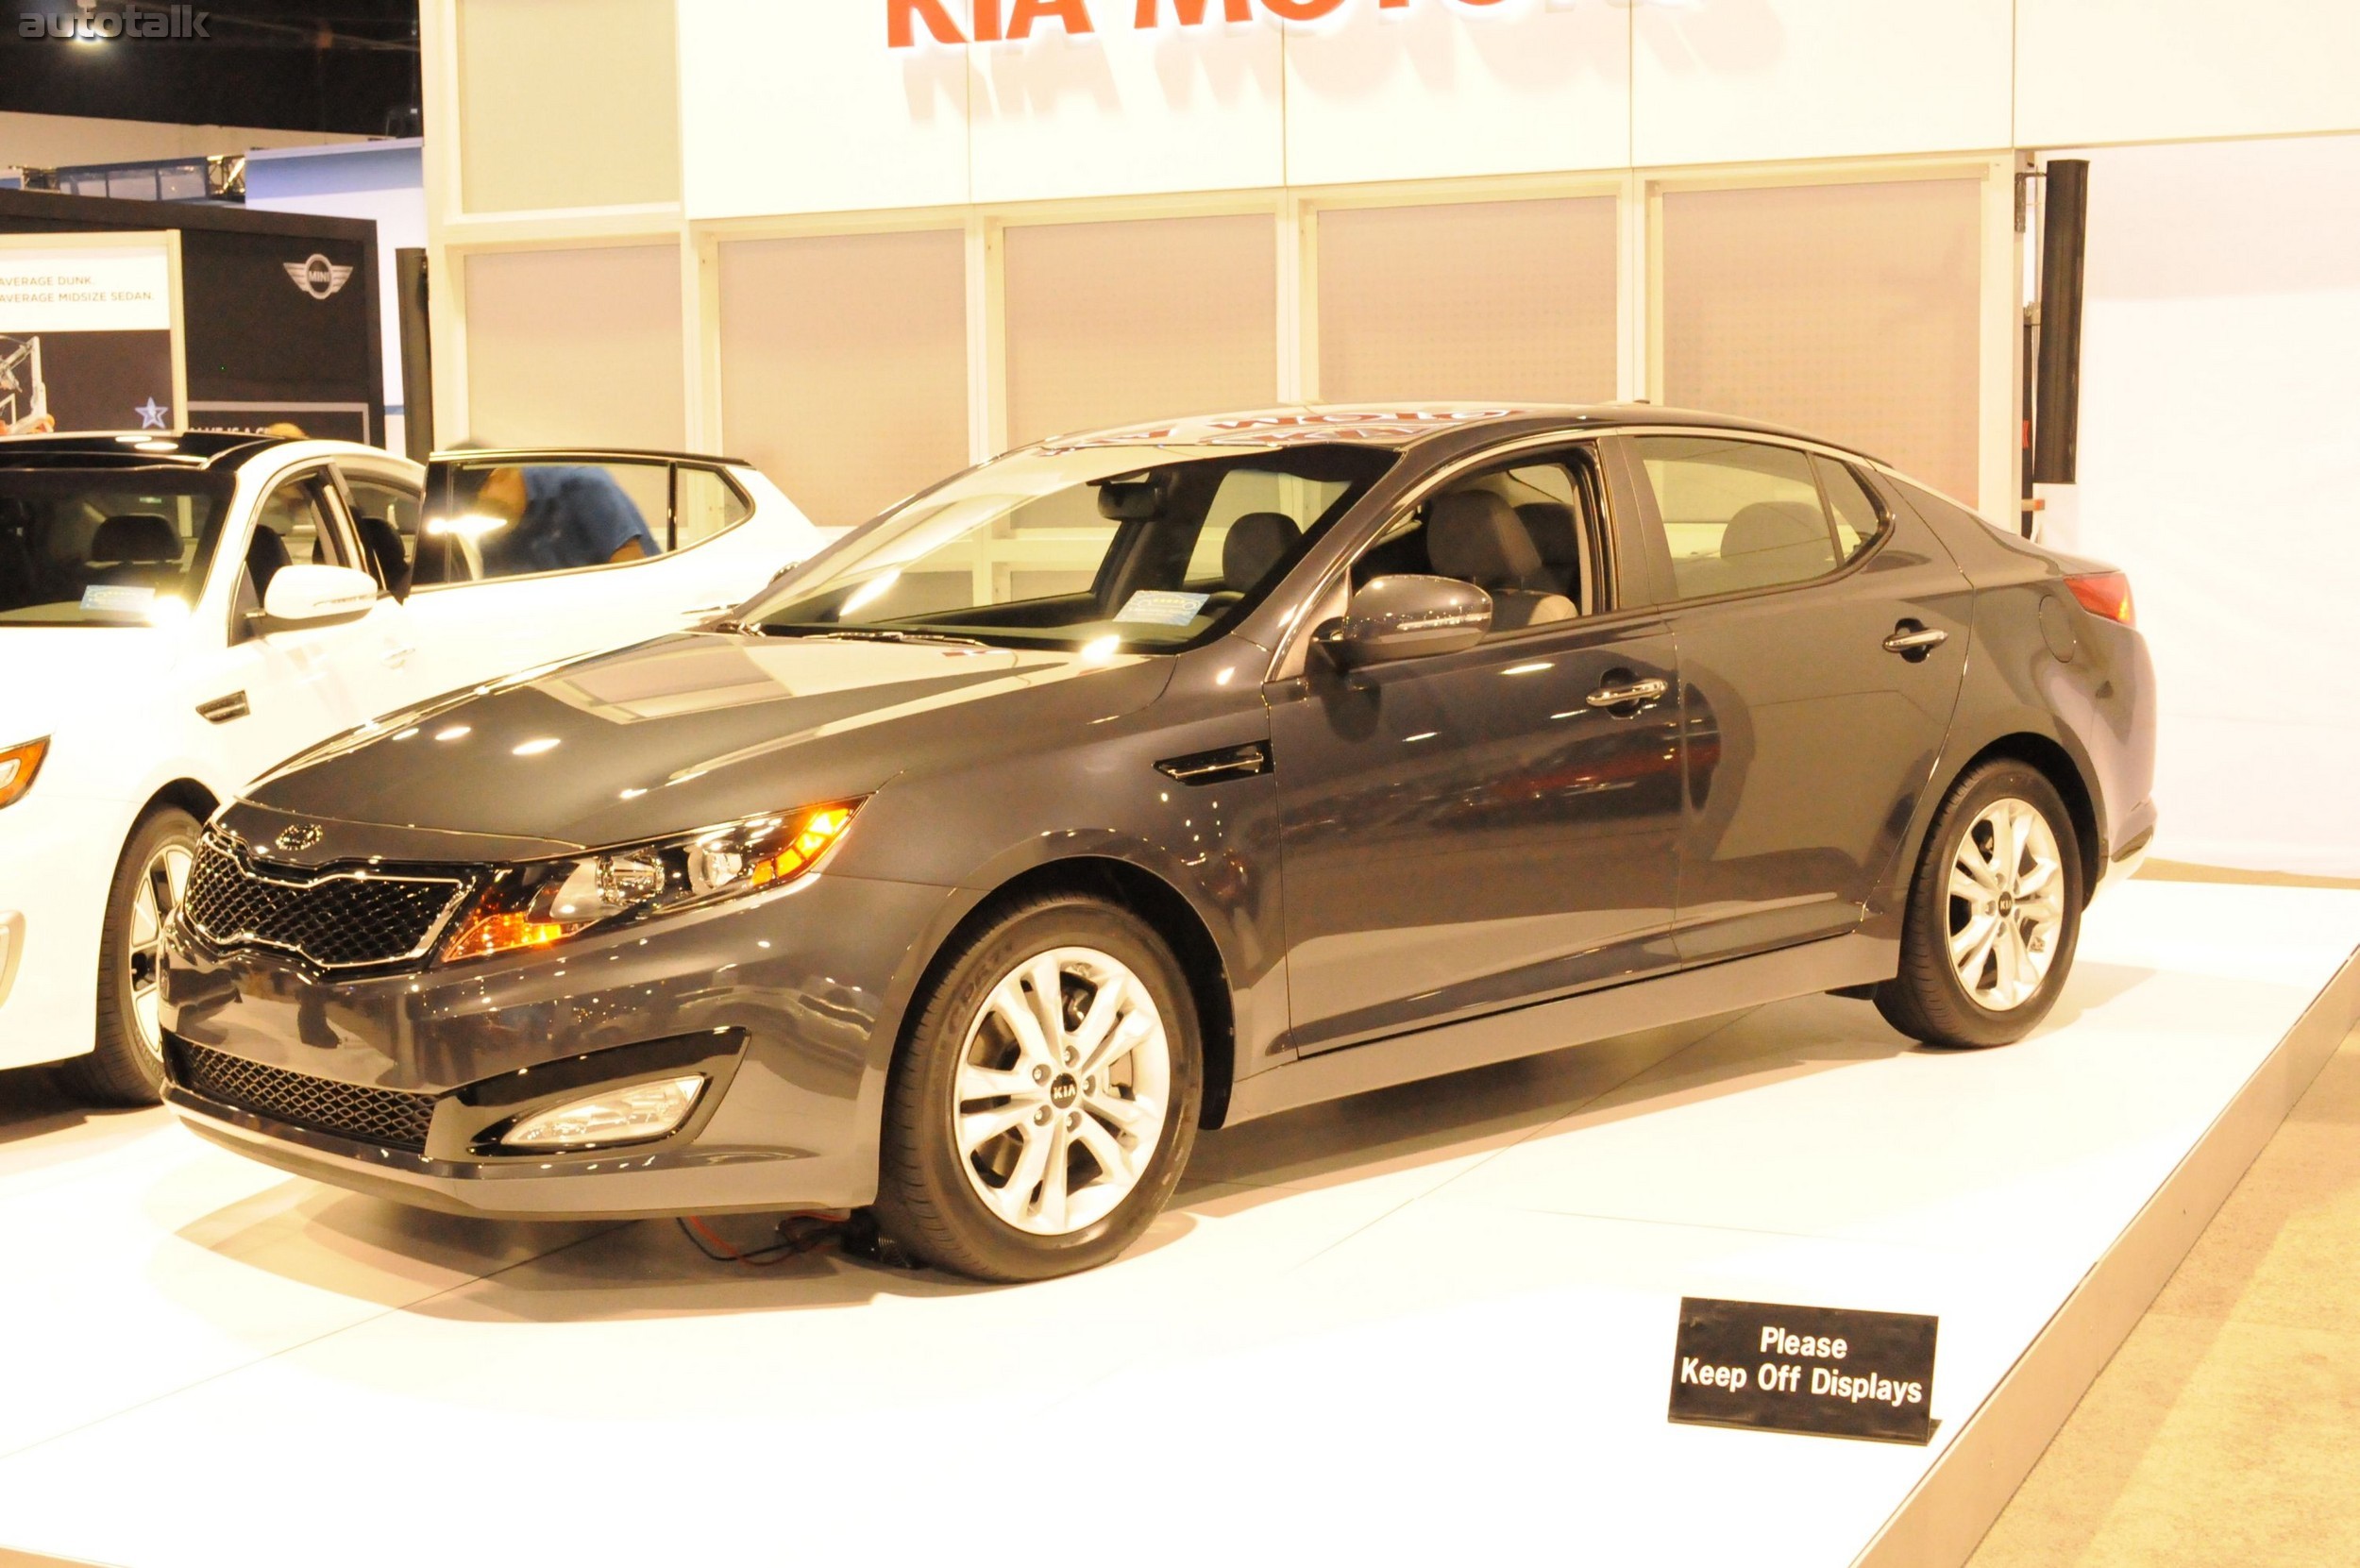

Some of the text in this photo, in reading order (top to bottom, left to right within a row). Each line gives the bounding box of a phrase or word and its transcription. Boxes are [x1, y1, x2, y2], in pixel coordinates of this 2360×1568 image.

[58, 276, 92, 286] DUNK
[309, 271, 330, 282] MINI
[0, 293, 54, 303] AVERAGE
[59, 292, 107, 302] MIDSIZE
[1054, 1085, 1075, 1099] KIA
[1760, 1325, 1847, 1359] Please
[1680, 1357, 1922, 1407] Keep Off Displays
